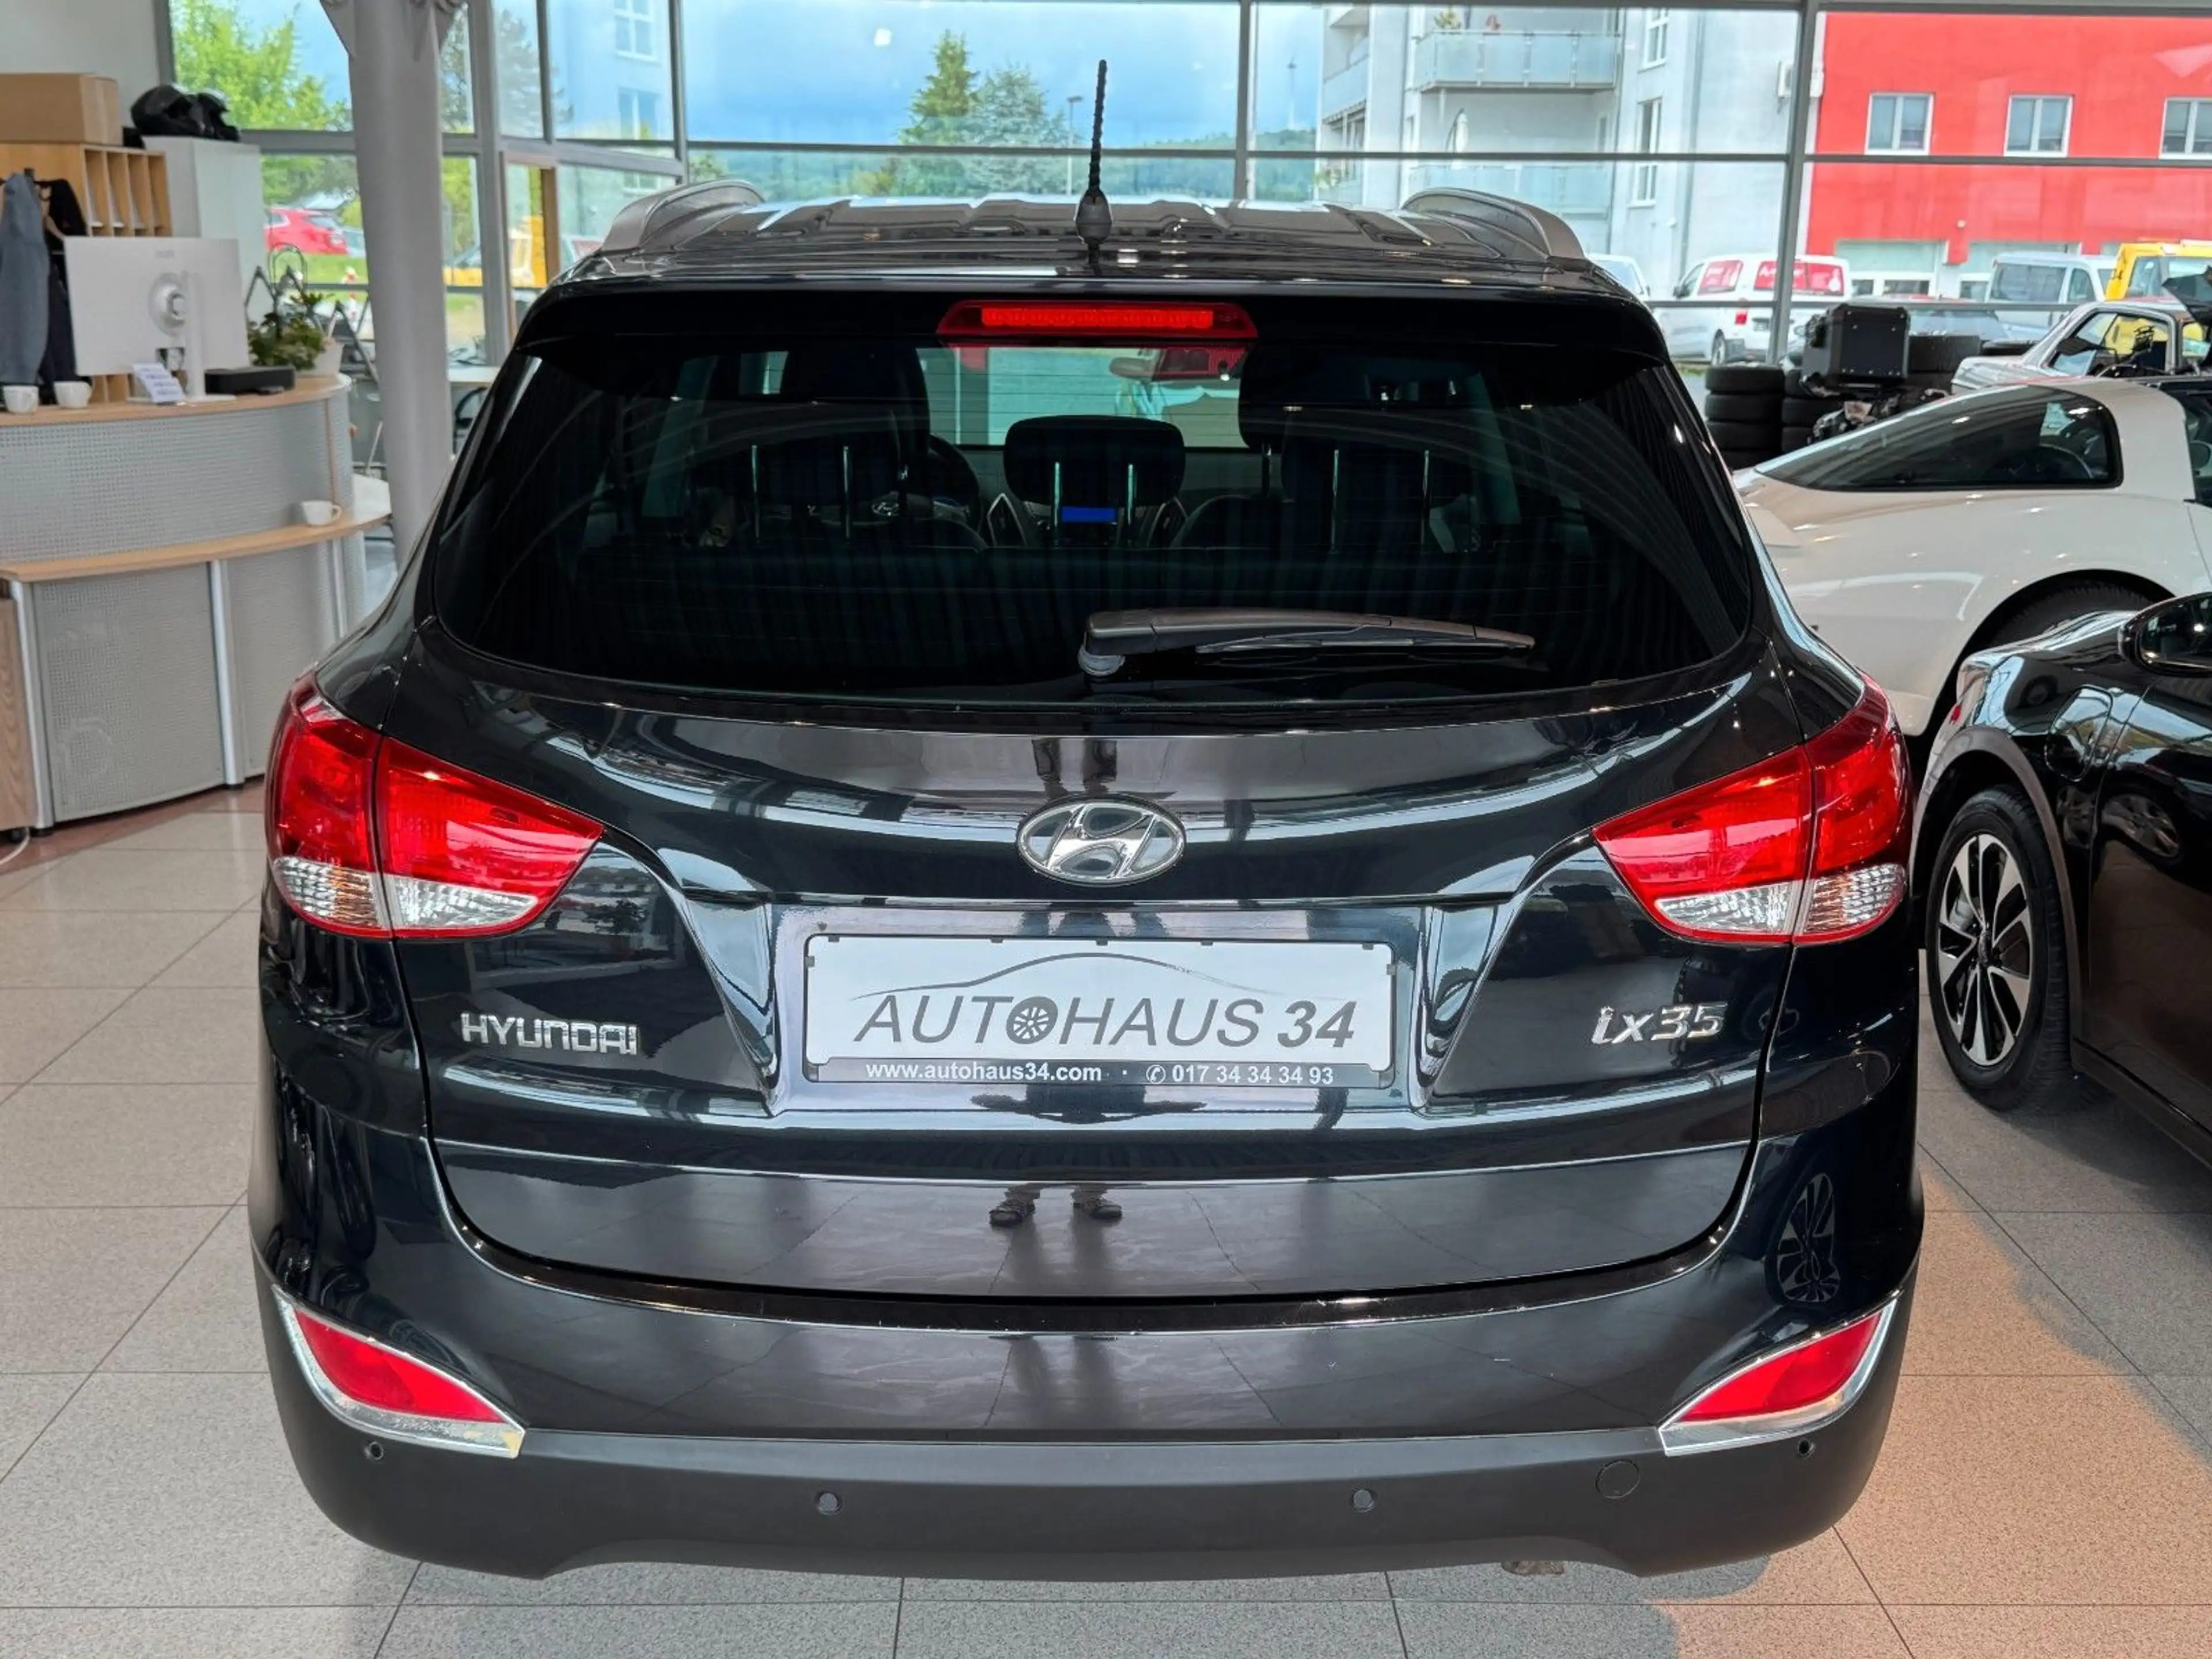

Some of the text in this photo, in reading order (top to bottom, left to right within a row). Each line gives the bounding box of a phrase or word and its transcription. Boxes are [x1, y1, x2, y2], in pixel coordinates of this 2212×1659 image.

[461, 1013, 637, 1055] HYUNDAI
[854, 995, 1357, 1047] AUTOHAUS 34
[1592, 1003, 1728, 1044] ix35
[866, 1062, 1334, 1085] www.autohaus34.com 017 34 34 34 93
